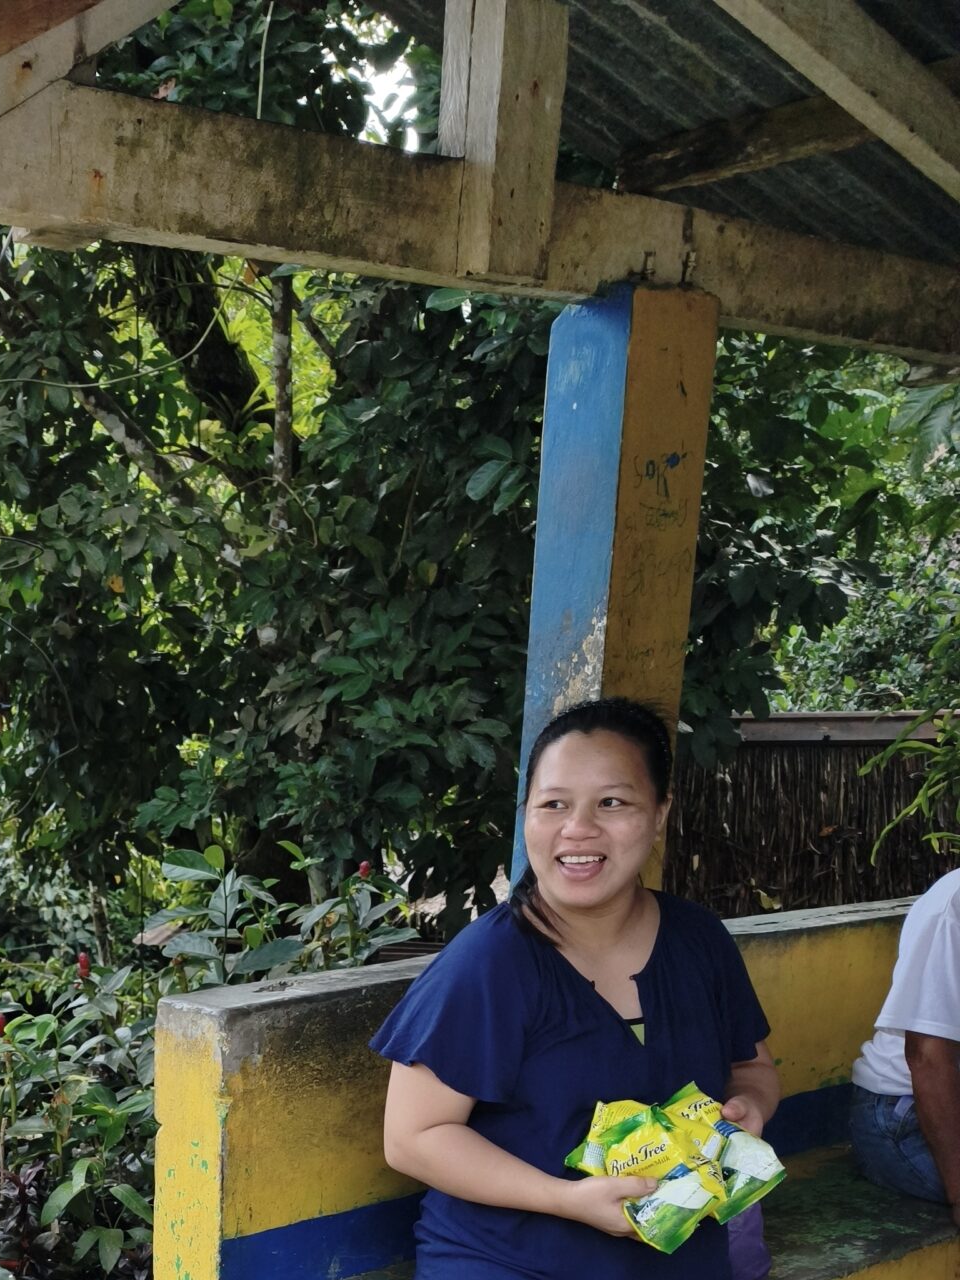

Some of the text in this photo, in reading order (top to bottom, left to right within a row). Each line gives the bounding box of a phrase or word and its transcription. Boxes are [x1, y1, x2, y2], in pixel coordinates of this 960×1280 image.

[611, 1154, 639, 1177] Birch
[638, 1141, 666, 1161] Tree
[654, 1155, 671, 1165] Milk
